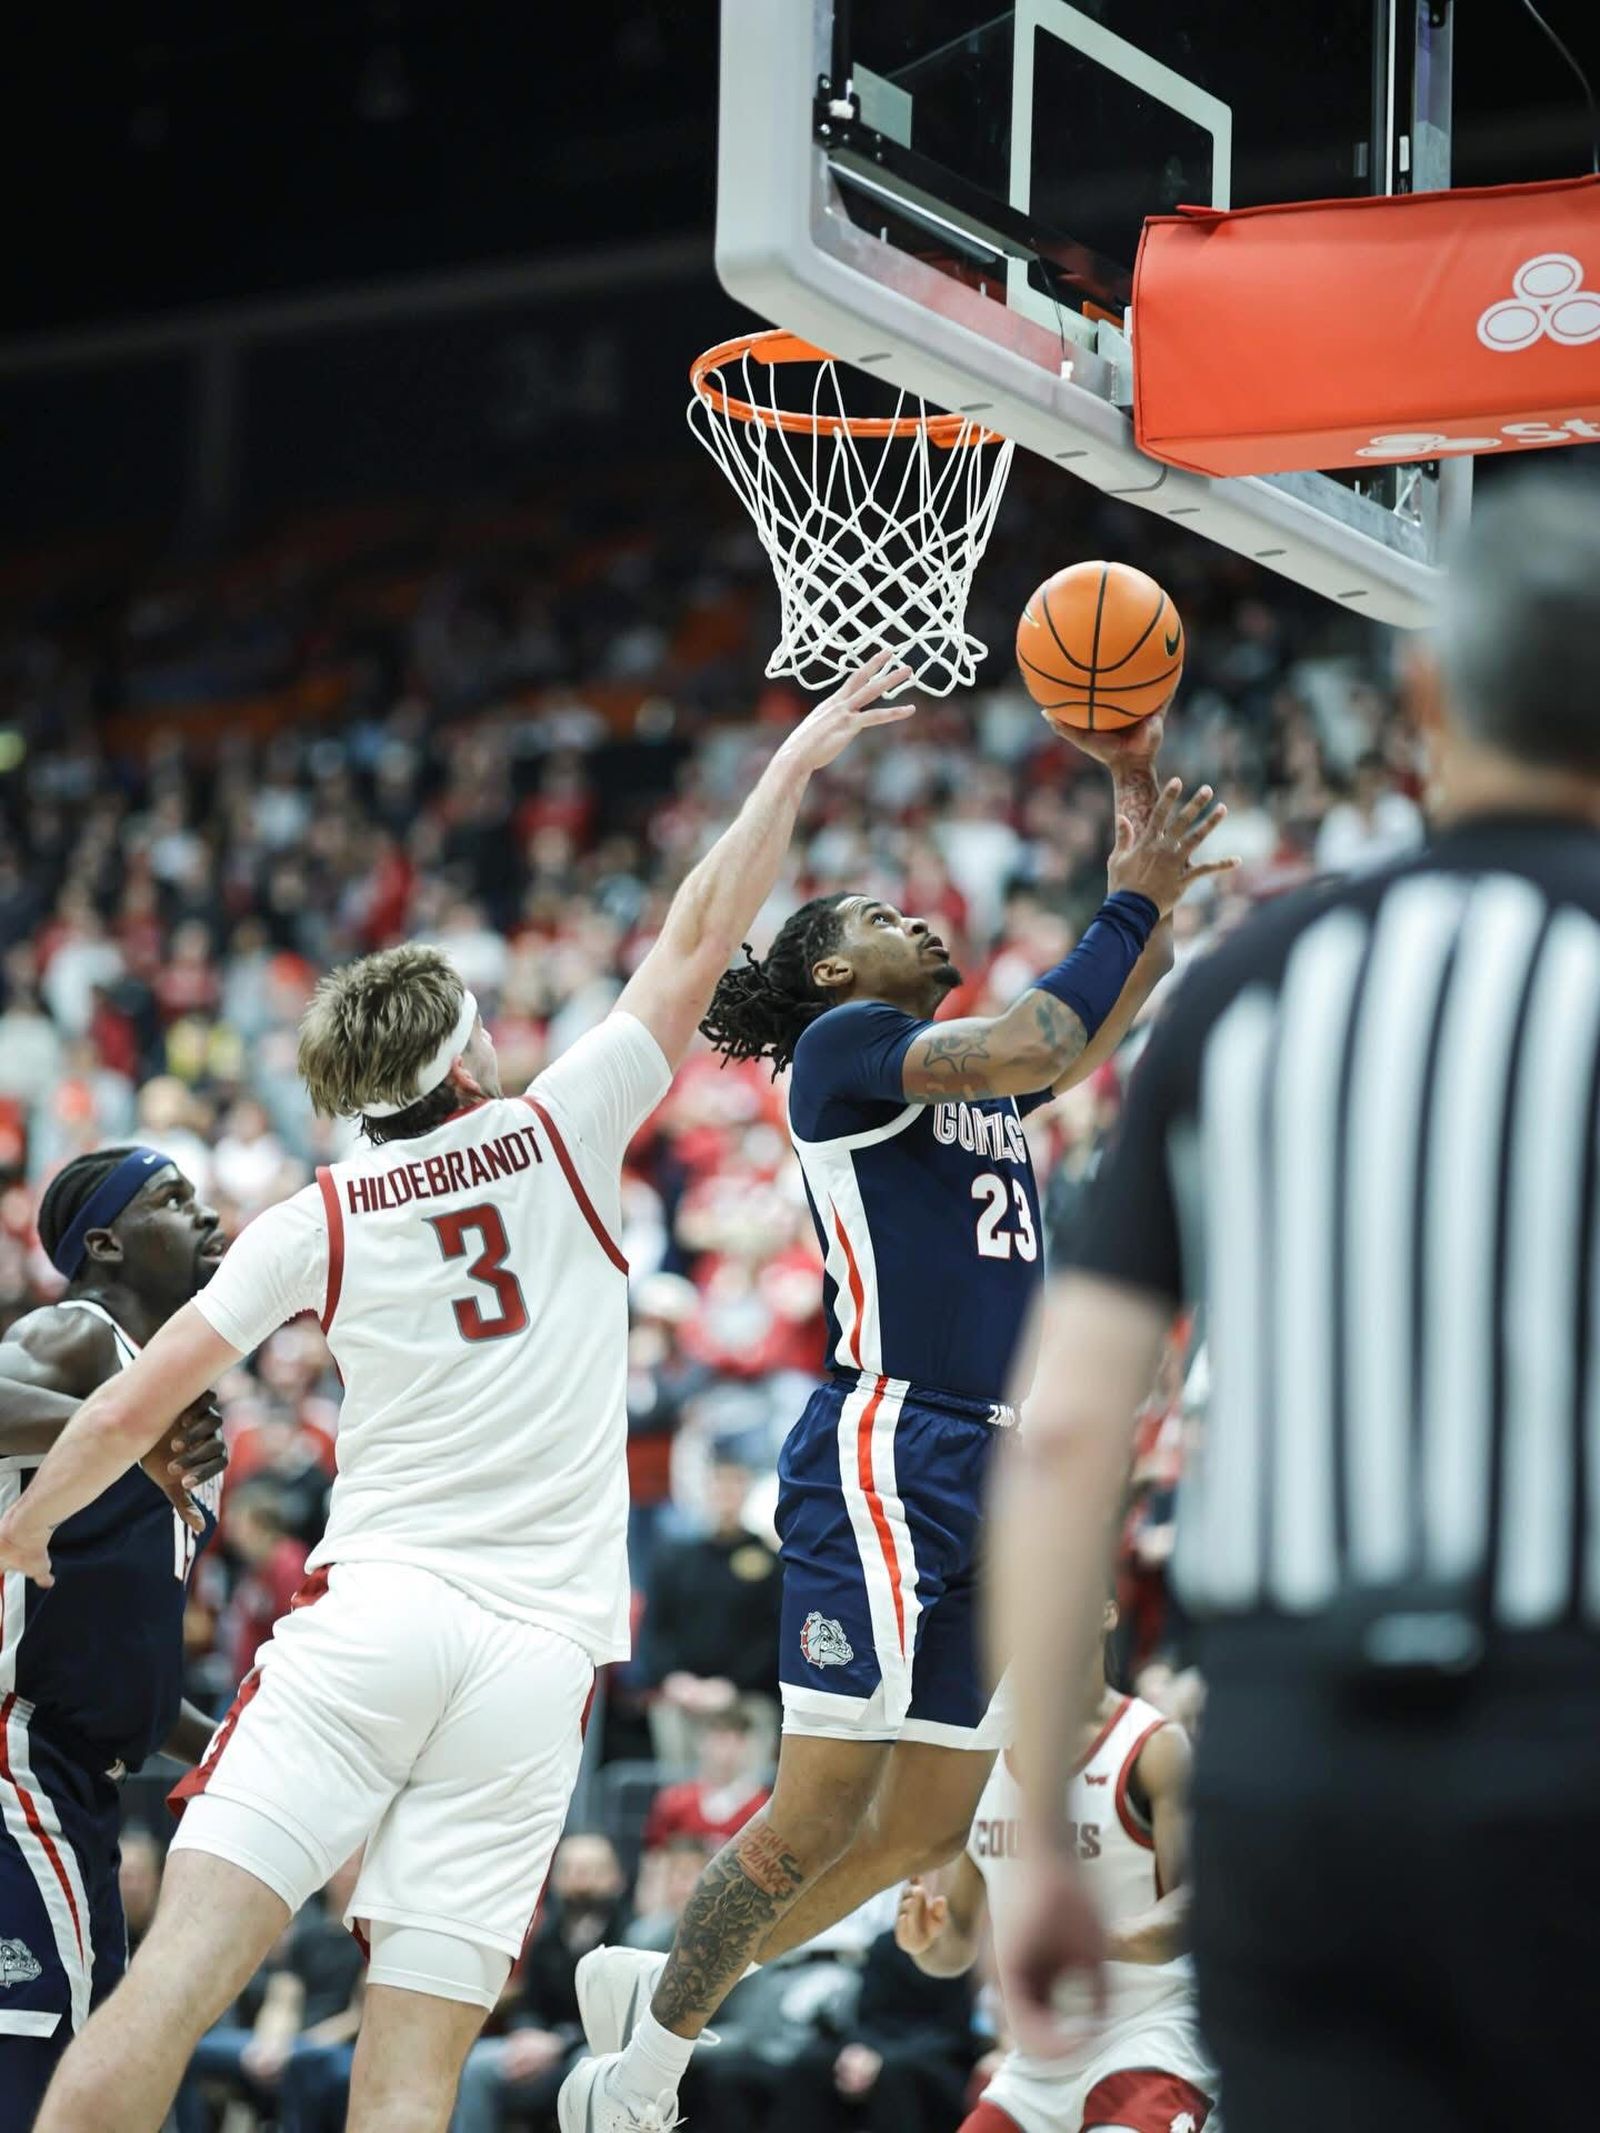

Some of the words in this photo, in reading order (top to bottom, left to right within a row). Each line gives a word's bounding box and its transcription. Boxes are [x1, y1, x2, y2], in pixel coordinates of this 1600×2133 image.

[1501, 418, 1600, 443] St
[347, 1126, 543, 1214] HILDEBRANDT
[971, 1173, 1037, 1263] 23
[421, 1202, 531, 1344] 3
